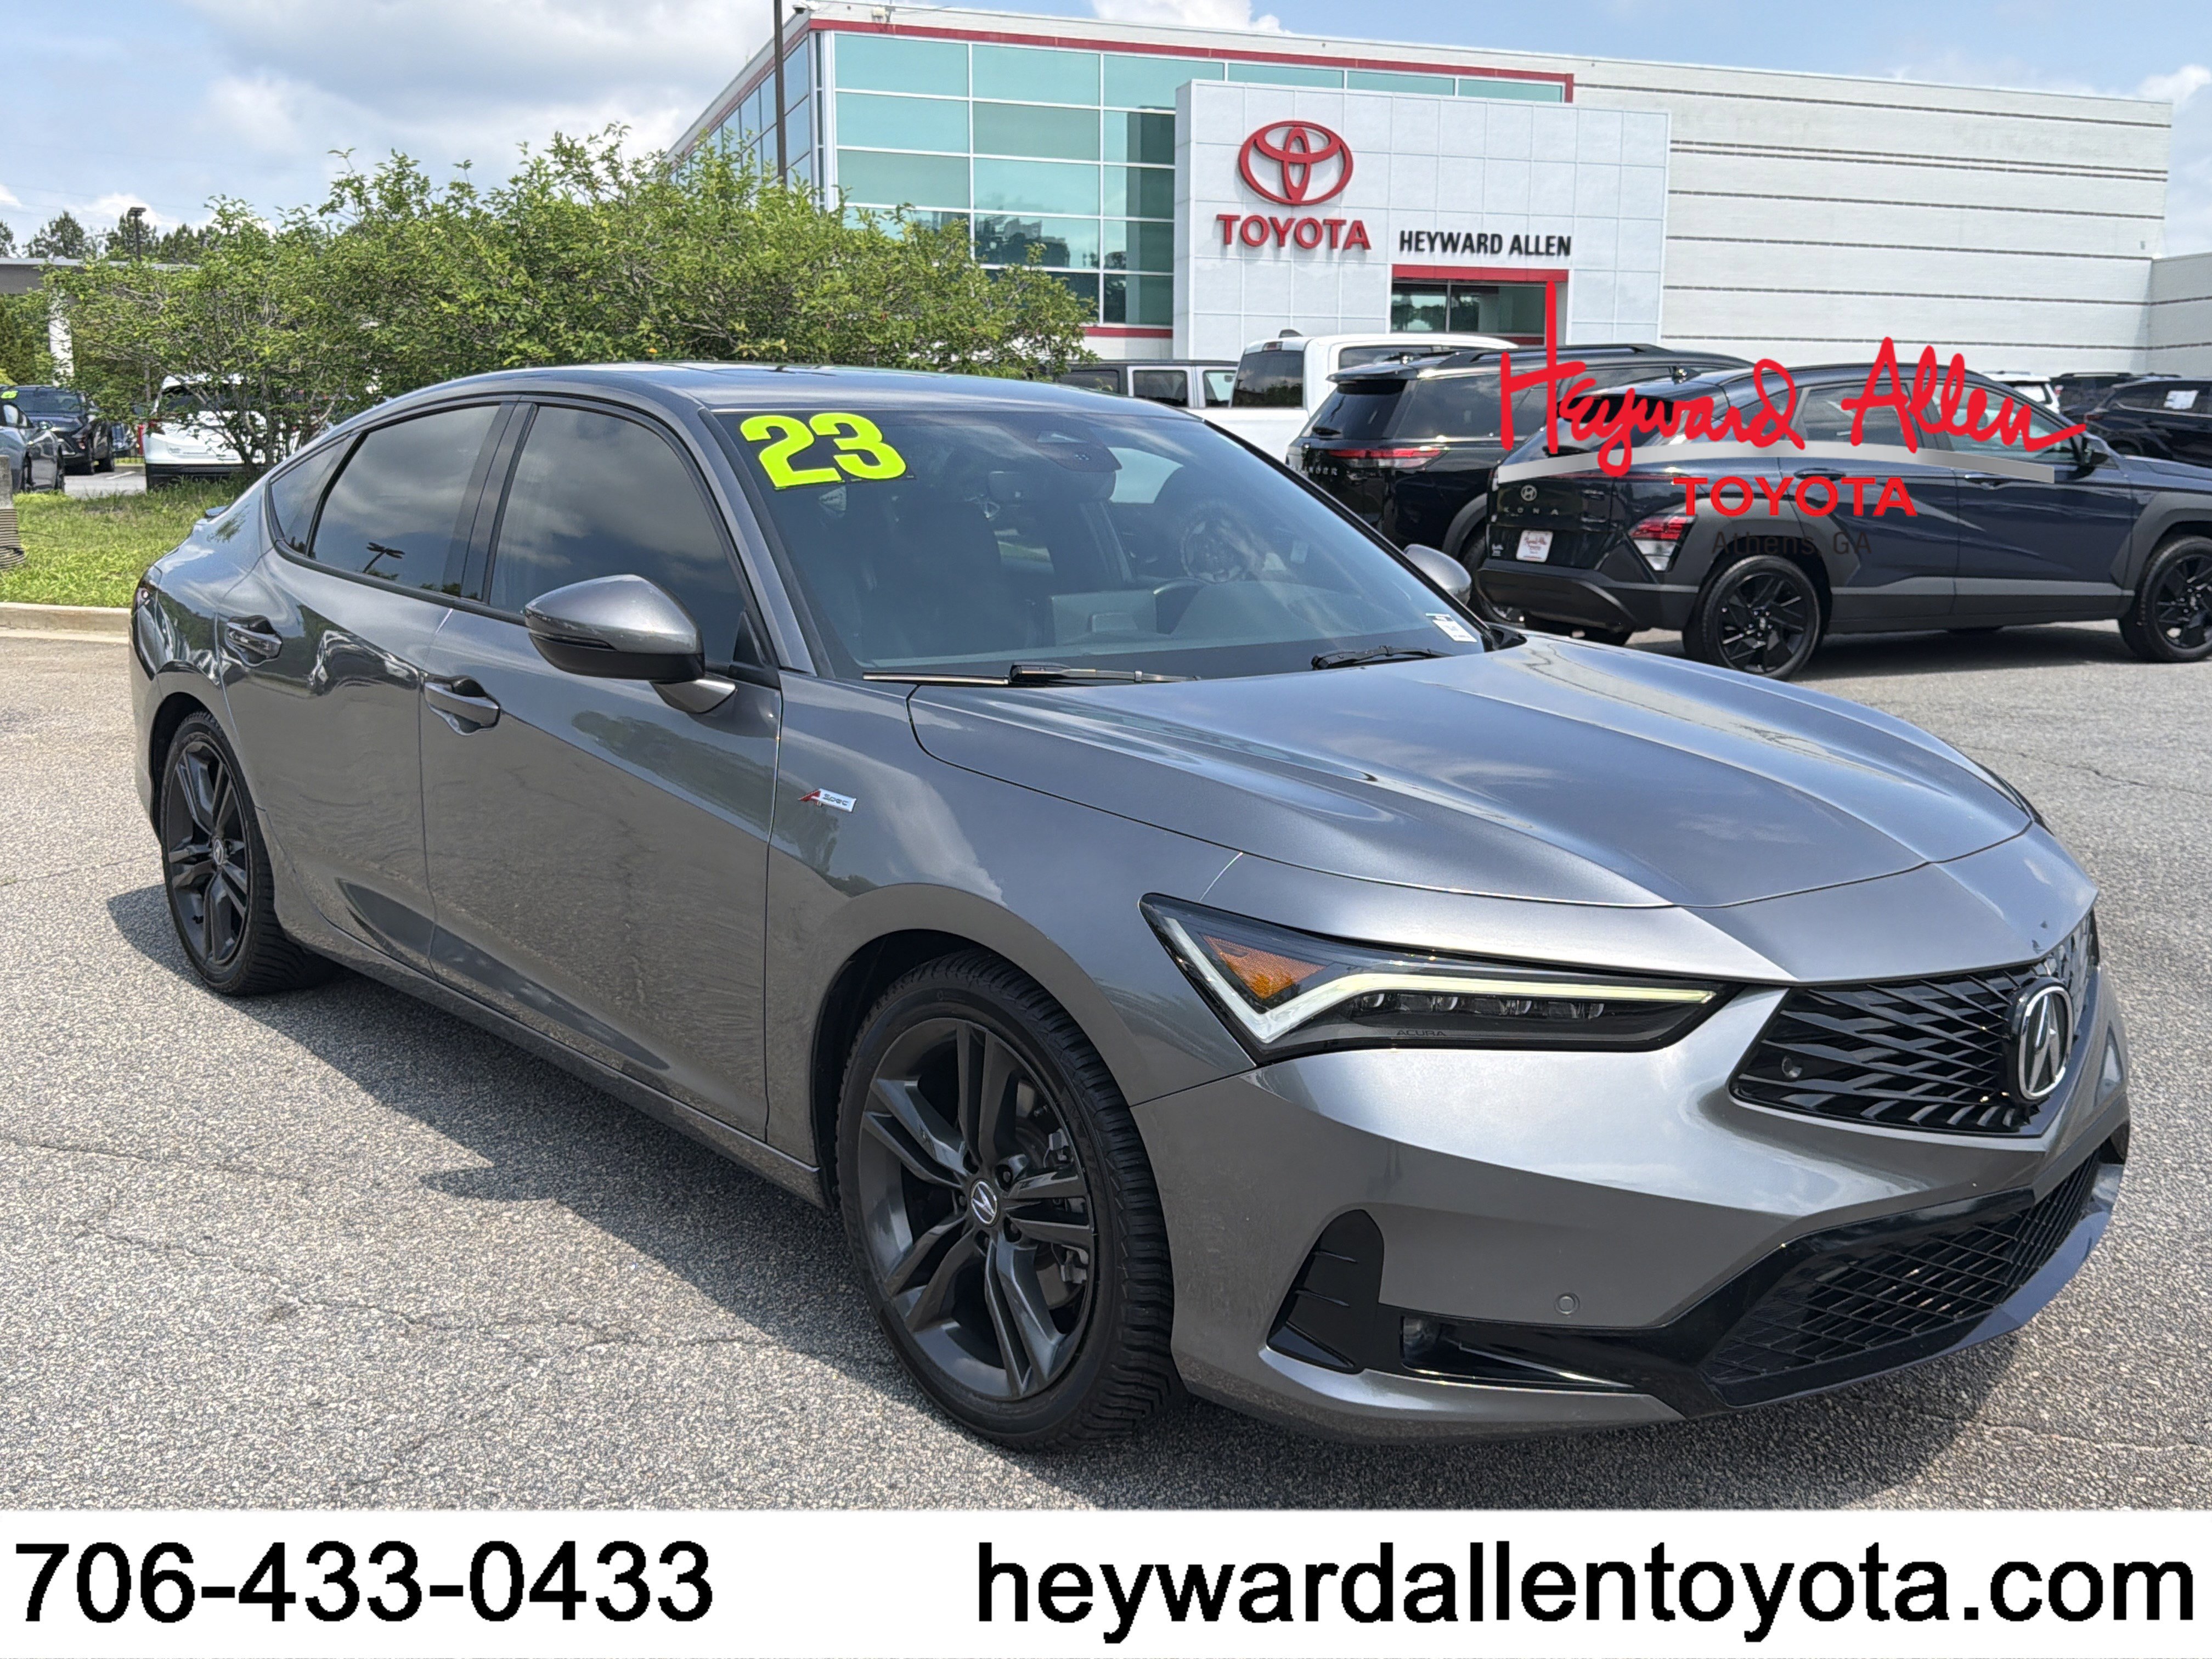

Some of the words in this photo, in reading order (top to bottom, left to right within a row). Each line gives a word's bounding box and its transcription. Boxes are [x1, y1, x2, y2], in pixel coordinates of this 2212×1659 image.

[1217, 214, 1371, 250] TOYOTA
[1399, 230, 1503, 255] HEYWARD
[1509, 234, 1572, 256] ALLEN
[740, 413, 906, 488] 23
[1504, 506, 1559, 516] KONA
